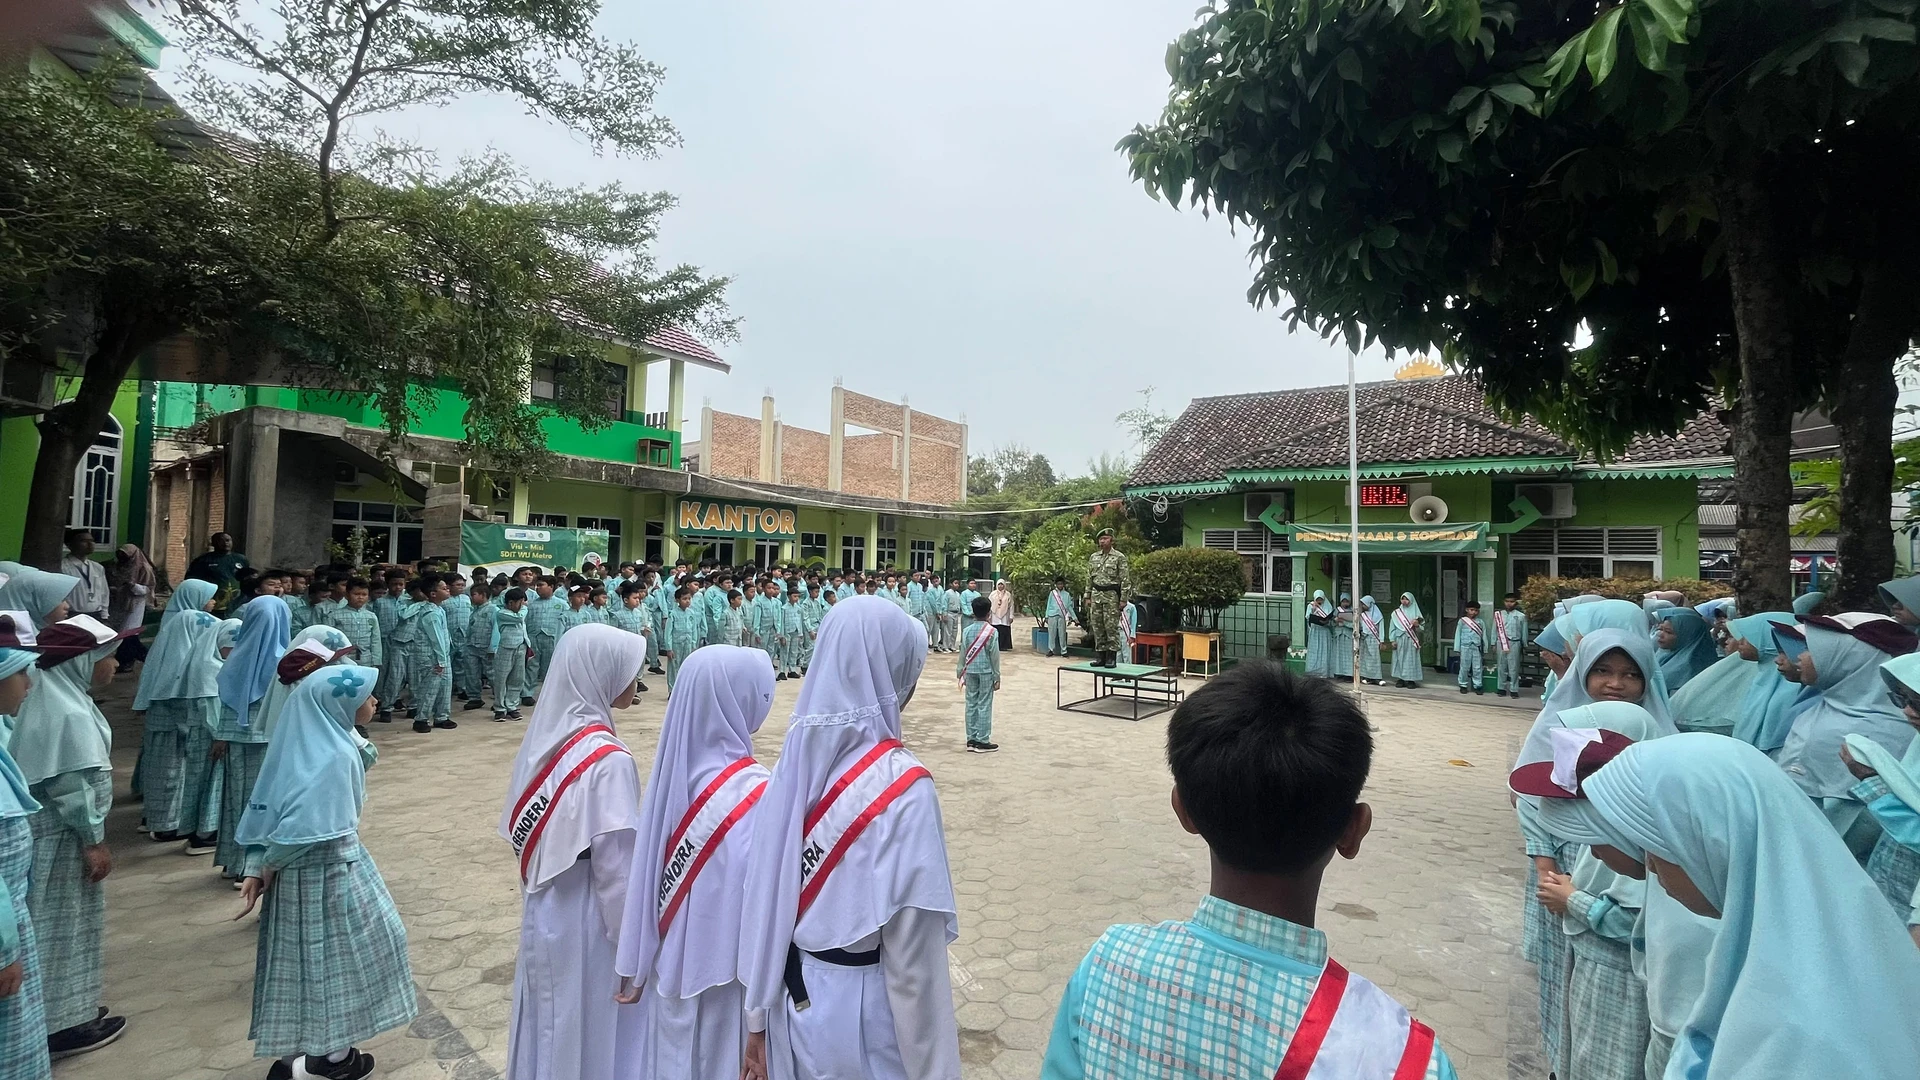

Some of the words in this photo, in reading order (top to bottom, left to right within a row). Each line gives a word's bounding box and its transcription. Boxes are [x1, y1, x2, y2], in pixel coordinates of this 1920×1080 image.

[680, 501, 795, 534] KANTOR
[1409, 530, 1478, 541] KOPERASI
[510, 542, 523, 550] Visi
[530, 543, 544, 551] Misi
[500, 550, 516, 558] SDIT
[517, 551, 531, 559] WU
[531, 552, 553, 560] Metro
[512, 795, 549, 847] BENDERA
